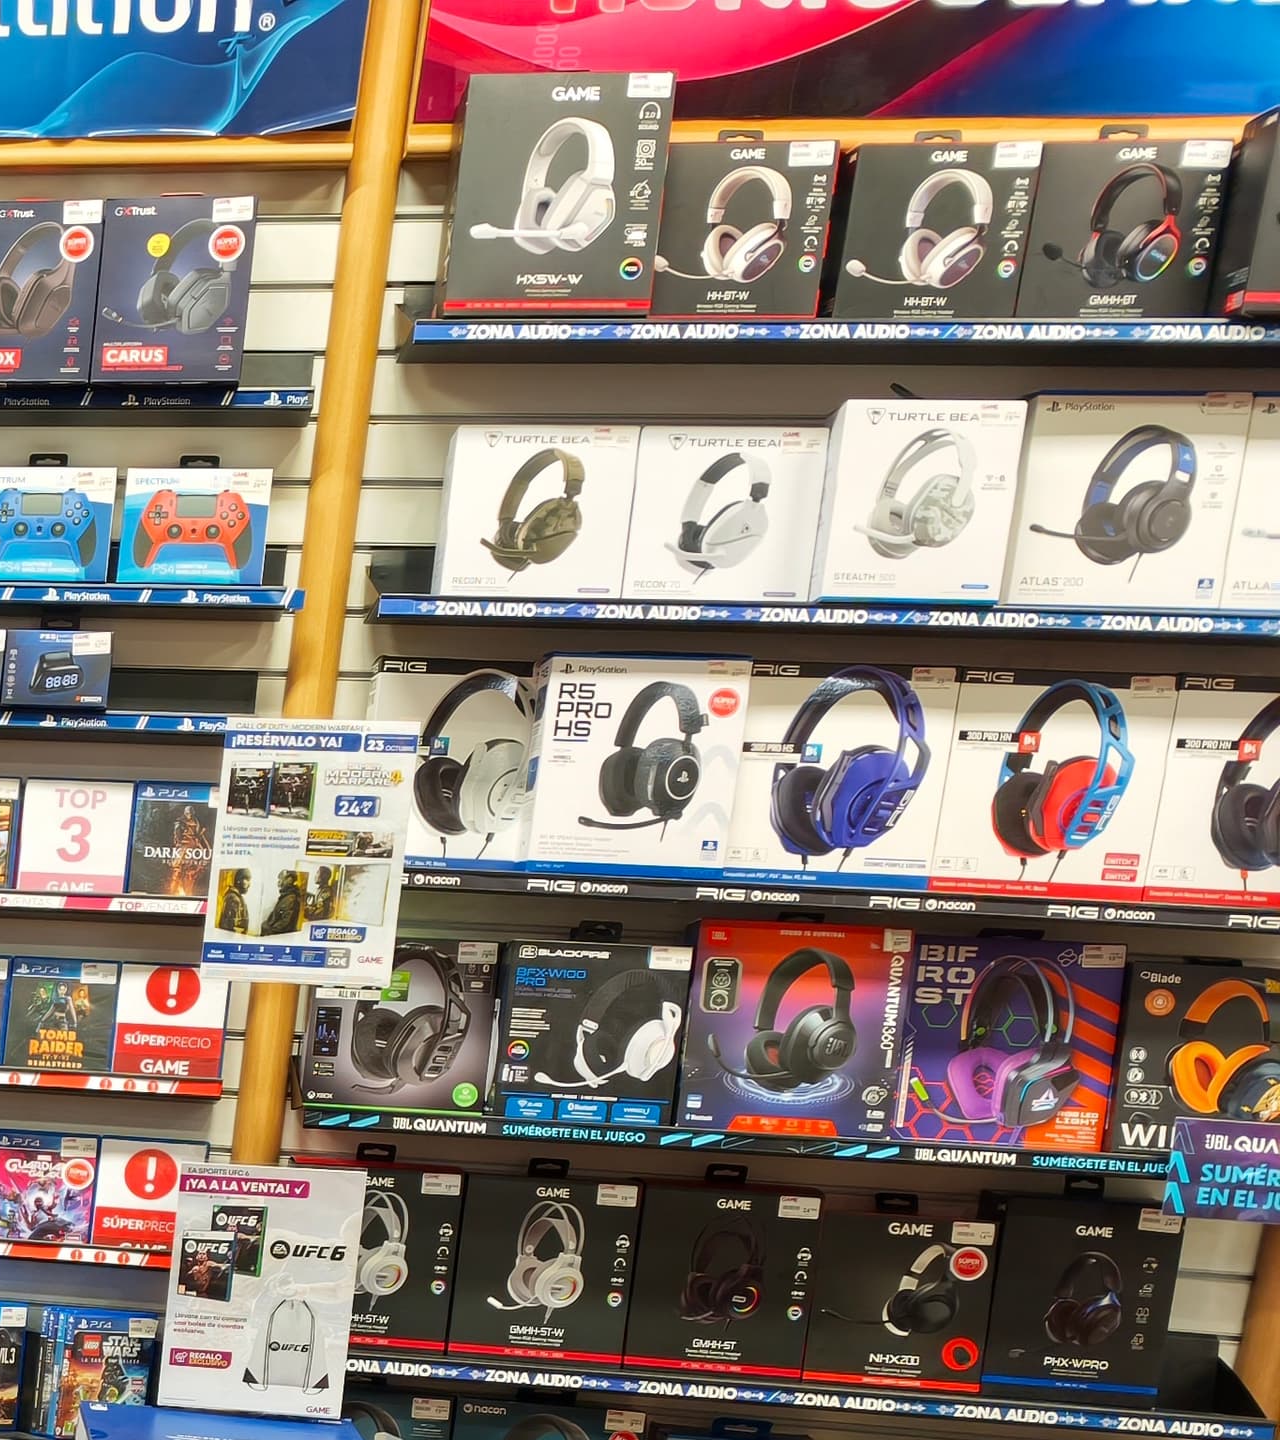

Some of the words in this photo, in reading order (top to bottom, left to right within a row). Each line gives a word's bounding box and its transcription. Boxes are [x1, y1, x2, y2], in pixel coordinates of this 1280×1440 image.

[551, 86, 600, 101] GAME
[932, 150, 968, 163] GAME
[467, 325, 516, 340] ZONA
[519, 325, 571, 340] AUDIO
[800, 325, 850, 340] ZONA
[853, 325, 911, 340] AUDIO
[106, 349, 164, 363] CARUS
[64, 591, 109, 601] PlayStation
[435, 602, 483, 617] ZONA
[486, 602, 537, 617] AUDIO
[1101, 615, 1153, 630] ZONA
[1157, 616, 1213, 631] AUDIO
[383, 660, 427, 672] RIG
[578, 665, 627, 676] PlayStation
[966, 670, 1014, 683] RIG
[559, 683, 595, 700] R5
[556, 701, 611, 719] PRO
[555, 719, 591, 736] HS
[232, 733, 315, 749] ¡RESÉRVALO
[319, 735, 343, 749] YA!
[367, 739, 385, 752] 23
[55, 788, 107, 809] TOP
[55, 816, 90, 863] 3
[592, 882, 628, 895] nacon
[1047, 905, 1099, 919] RIG
[1117, 908, 1155, 921] nacon
[1150, 972, 1182, 985] Blade
[140, 1058, 189, 1076] GAME
[413, 1118, 487, 1134] QUANTUM
[502, 1123, 571, 1139] SUMÉRGETE
[572, 1129, 589, 1139] EN
[591, 1130, 602, 1140] EL
[604, 1131, 646, 1143] JUEGO
[186, 1179, 207, 1191] ¡YA
[209, 1180, 219, 1190] A
[222, 1181, 238, 1191] LA
[241, 1182, 290, 1194] VENTA!
[536, 1186, 570, 1199] GAME
[1197, 1187, 1230, 1206] EN
[1234, 1190, 1257, 1209] EL
[888, 1222, 932, 1237] GAME
[486, 1369, 531, 1385] ZONA
[532, 1371, 582, 1388] AUDIO
